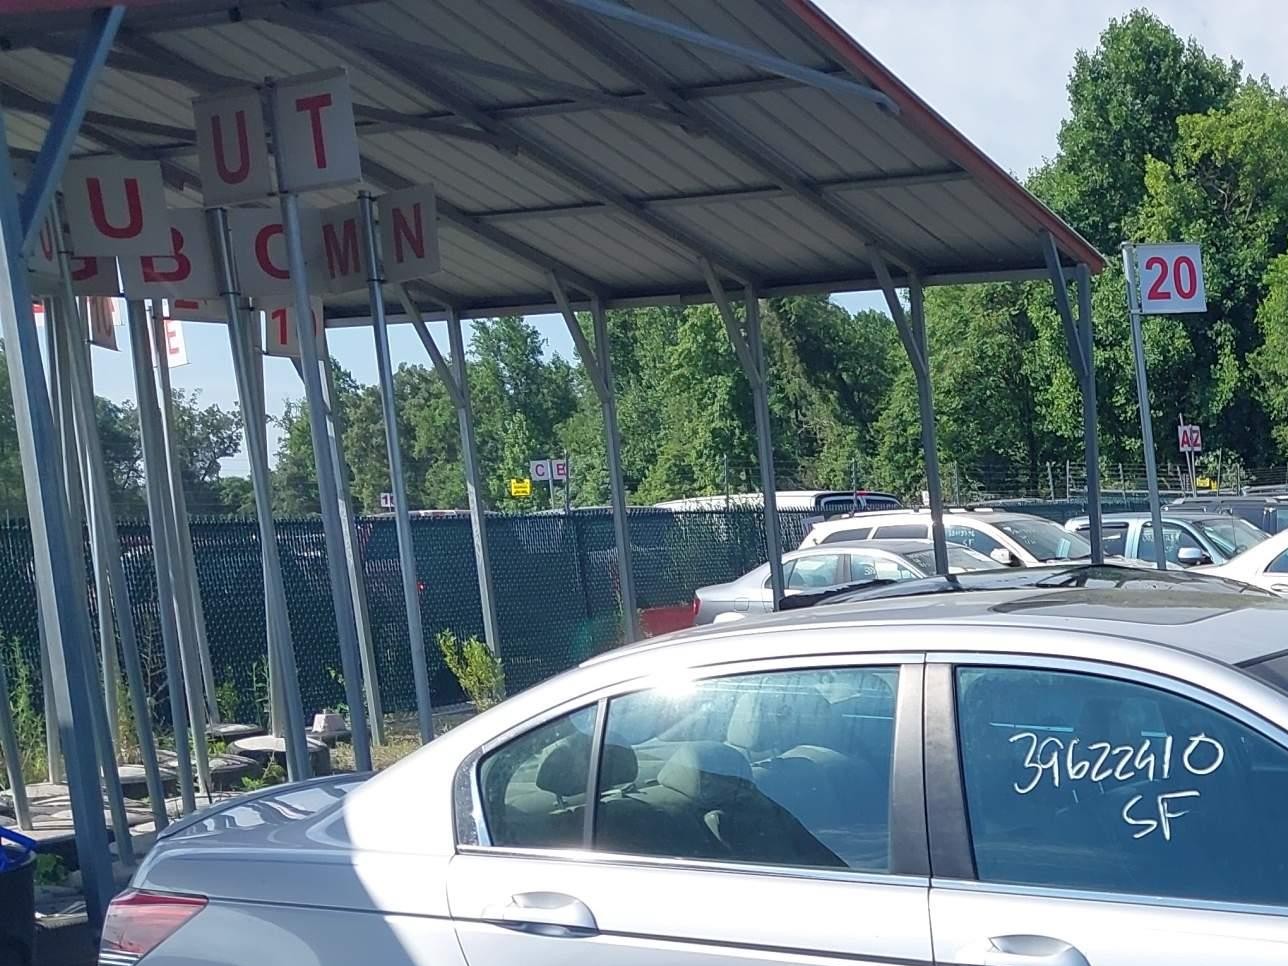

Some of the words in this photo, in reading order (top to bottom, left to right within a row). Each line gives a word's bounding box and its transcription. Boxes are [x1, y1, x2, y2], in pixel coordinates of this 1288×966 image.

[211, 110, 250, 185] U
[296, 93, 332, 169] T
[86, 177, 143, 240] U
[392, 202, 425, 263] N
[322, 218, 361, 280] M
[1145, 255, 1197, 300] 20
[535, 463, 546, 477] C
[1008, 731, 1225, 795] 39622410
[1122, 789, 1201, 841] SF
